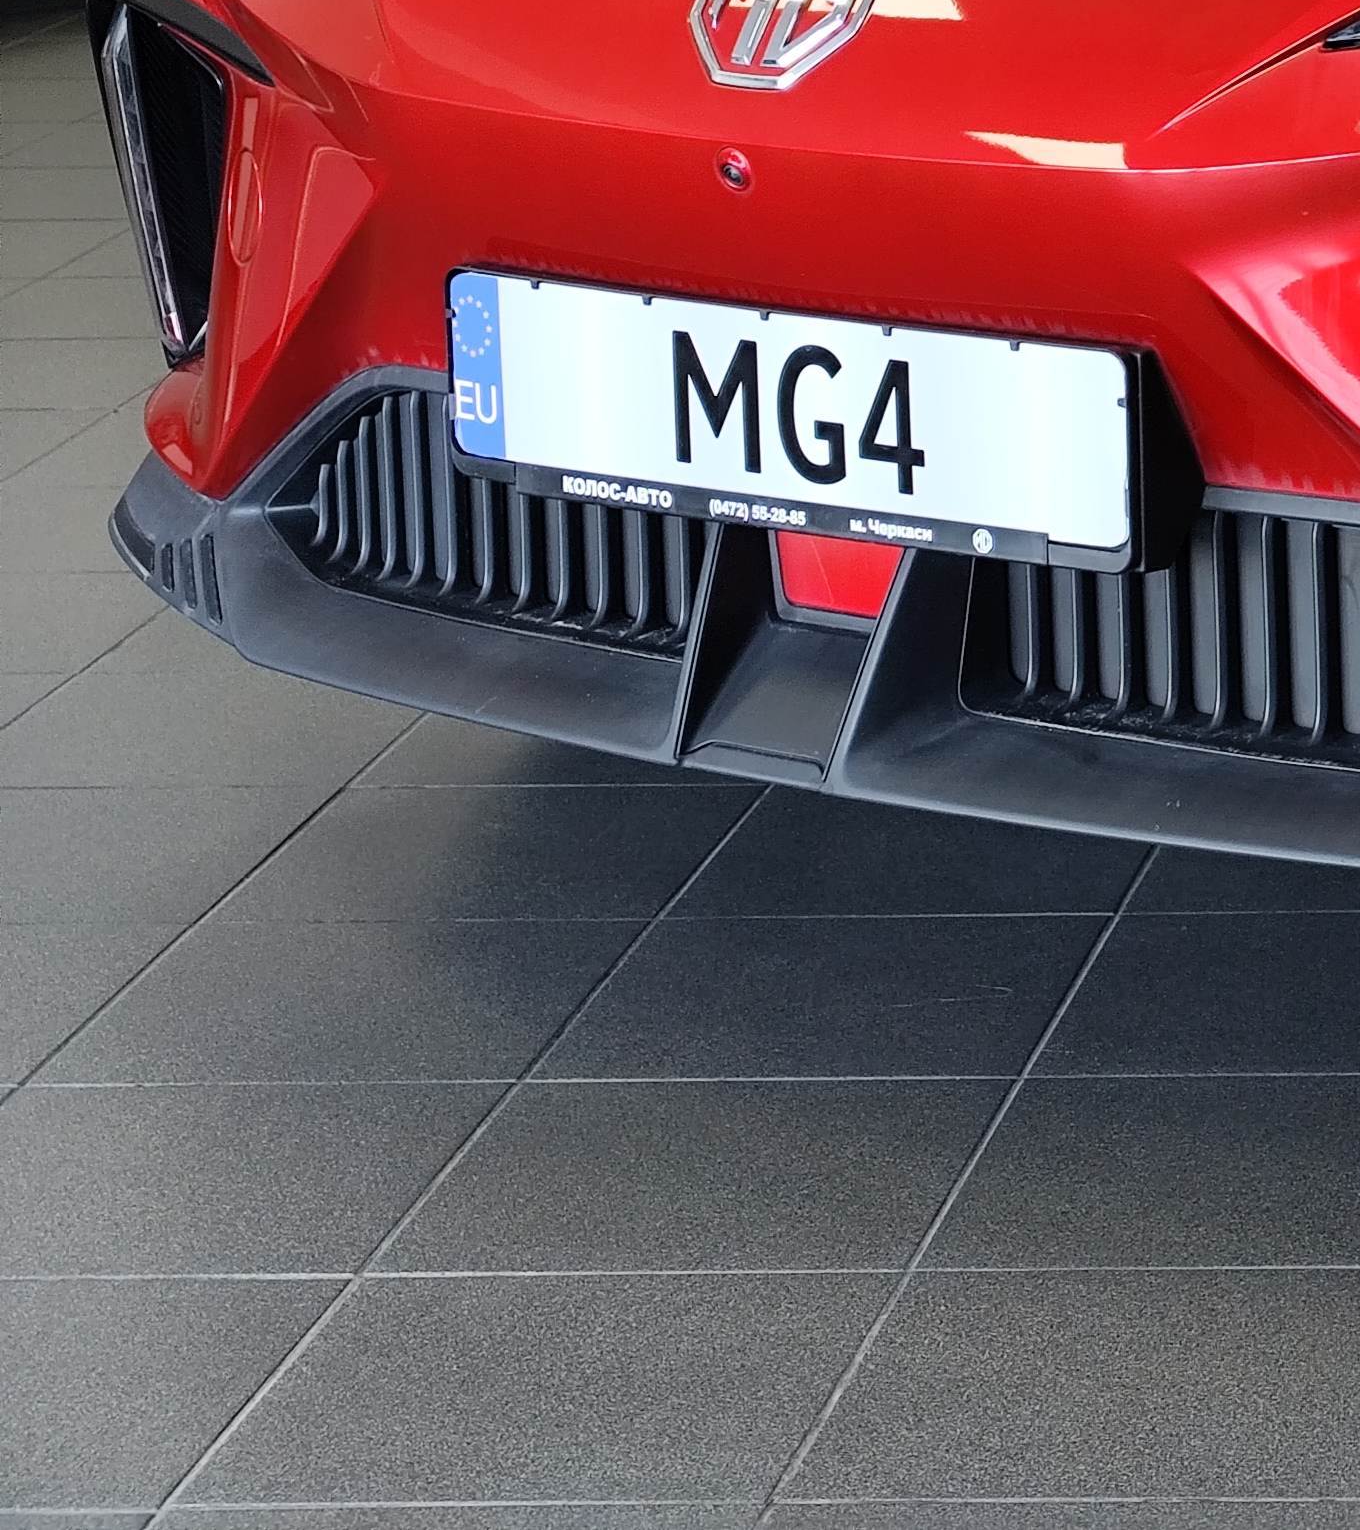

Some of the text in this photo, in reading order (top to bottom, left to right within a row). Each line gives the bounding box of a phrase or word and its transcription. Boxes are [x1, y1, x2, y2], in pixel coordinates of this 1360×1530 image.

[454, 379, 499, 424] EU
[671, 329, 926, 496] MG4
[562, 473, 674, 509] КОЛОС-АВТО
[708, 497, 807, 528] (0472) 55-28-85
[849, 517, 933, 543] м. Черкаси
